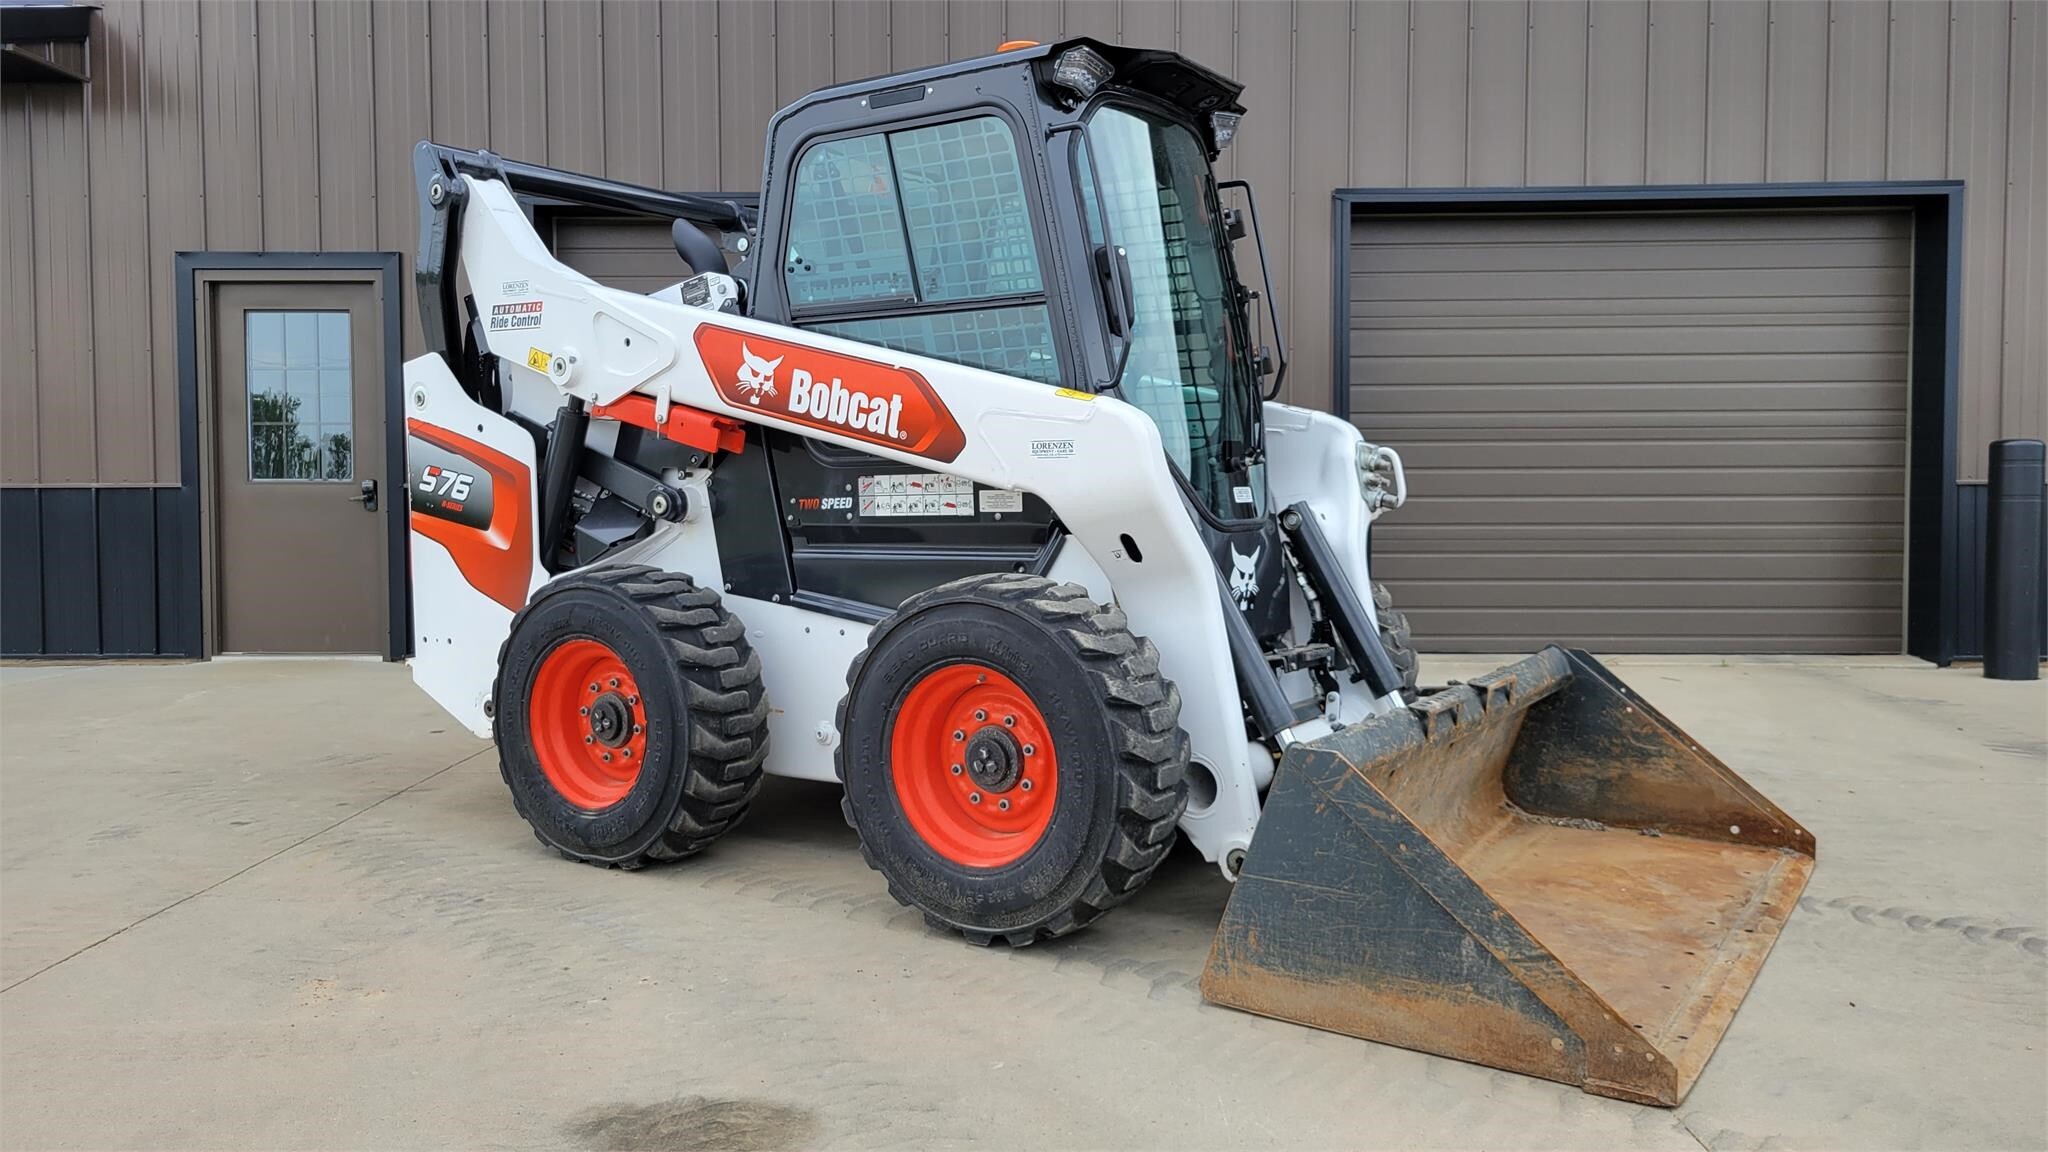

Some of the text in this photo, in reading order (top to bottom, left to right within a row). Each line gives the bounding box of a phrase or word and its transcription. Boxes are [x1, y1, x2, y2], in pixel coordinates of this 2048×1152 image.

[493, 302, 543, 314] AUTOMATIC
[490, 313, 542, 329] Ride Control
[1031, 441, 1074, 450] LORENZEN
[418, 464, 474, 502] S76
[798, 496, 853, 509] TWO SPEED
